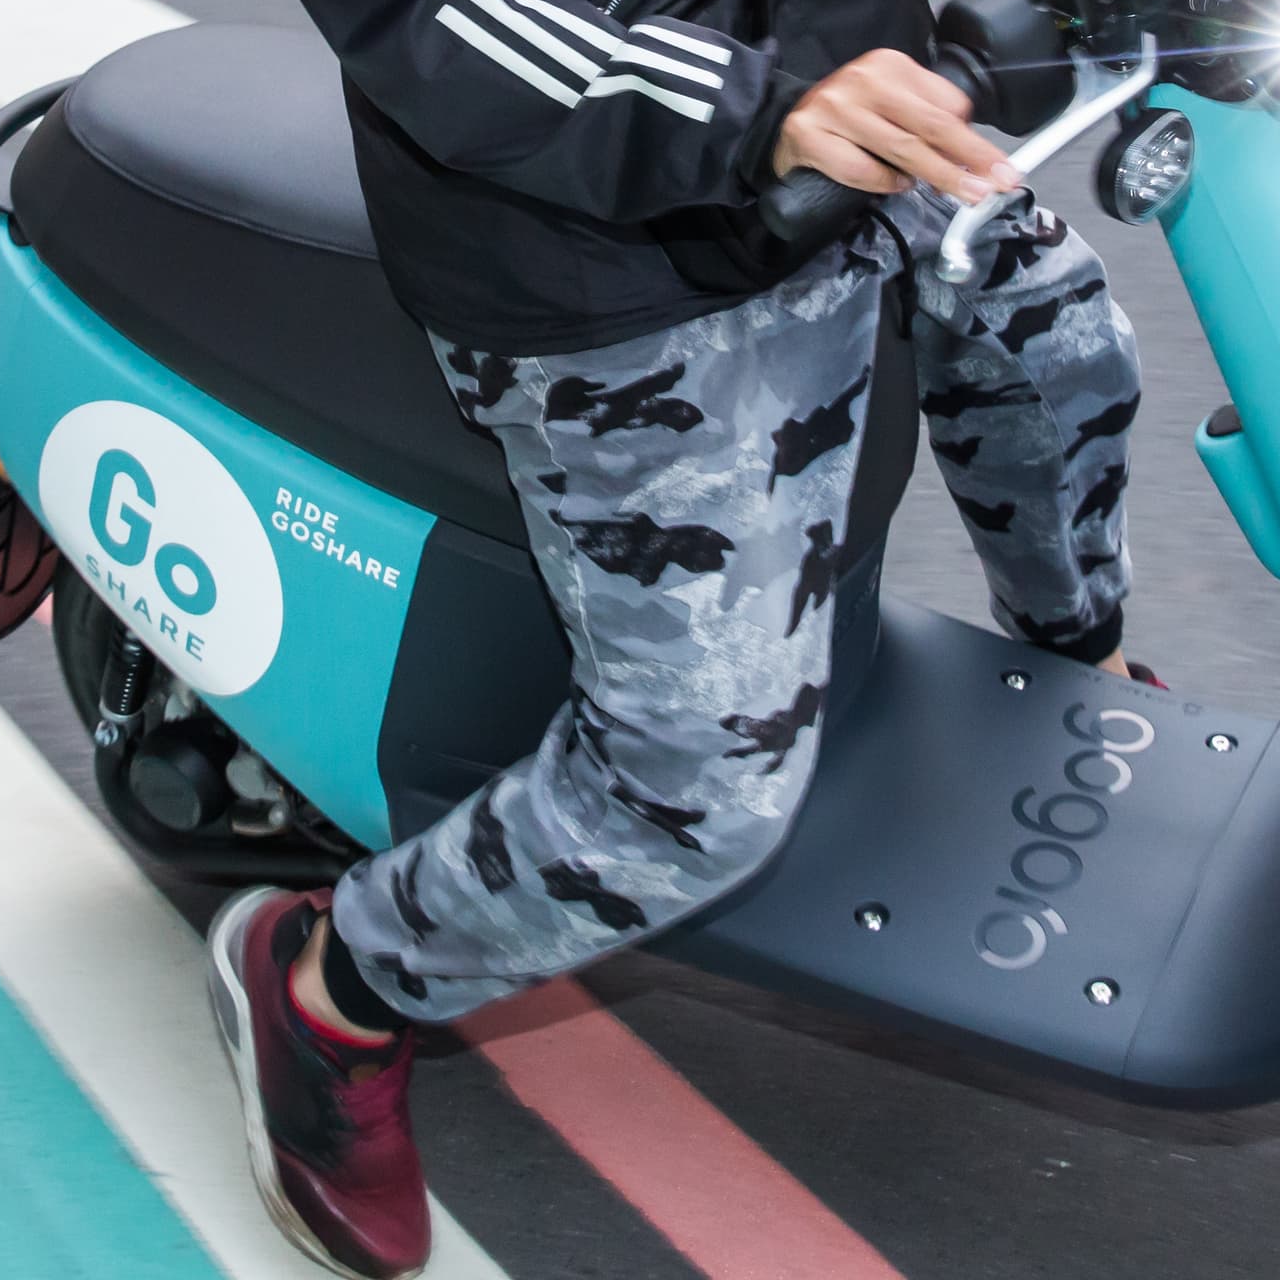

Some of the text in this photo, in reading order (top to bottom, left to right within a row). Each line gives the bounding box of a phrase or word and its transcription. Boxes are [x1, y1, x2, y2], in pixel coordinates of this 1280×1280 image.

[89, 448, 218, 616] Go
[272, 510, 401, 589] GOSHARE
[277, 487, 339, 532] RIDE
[85, 553, 206, 662] SHARE
[975, 703, 1154, 969] gogoro
